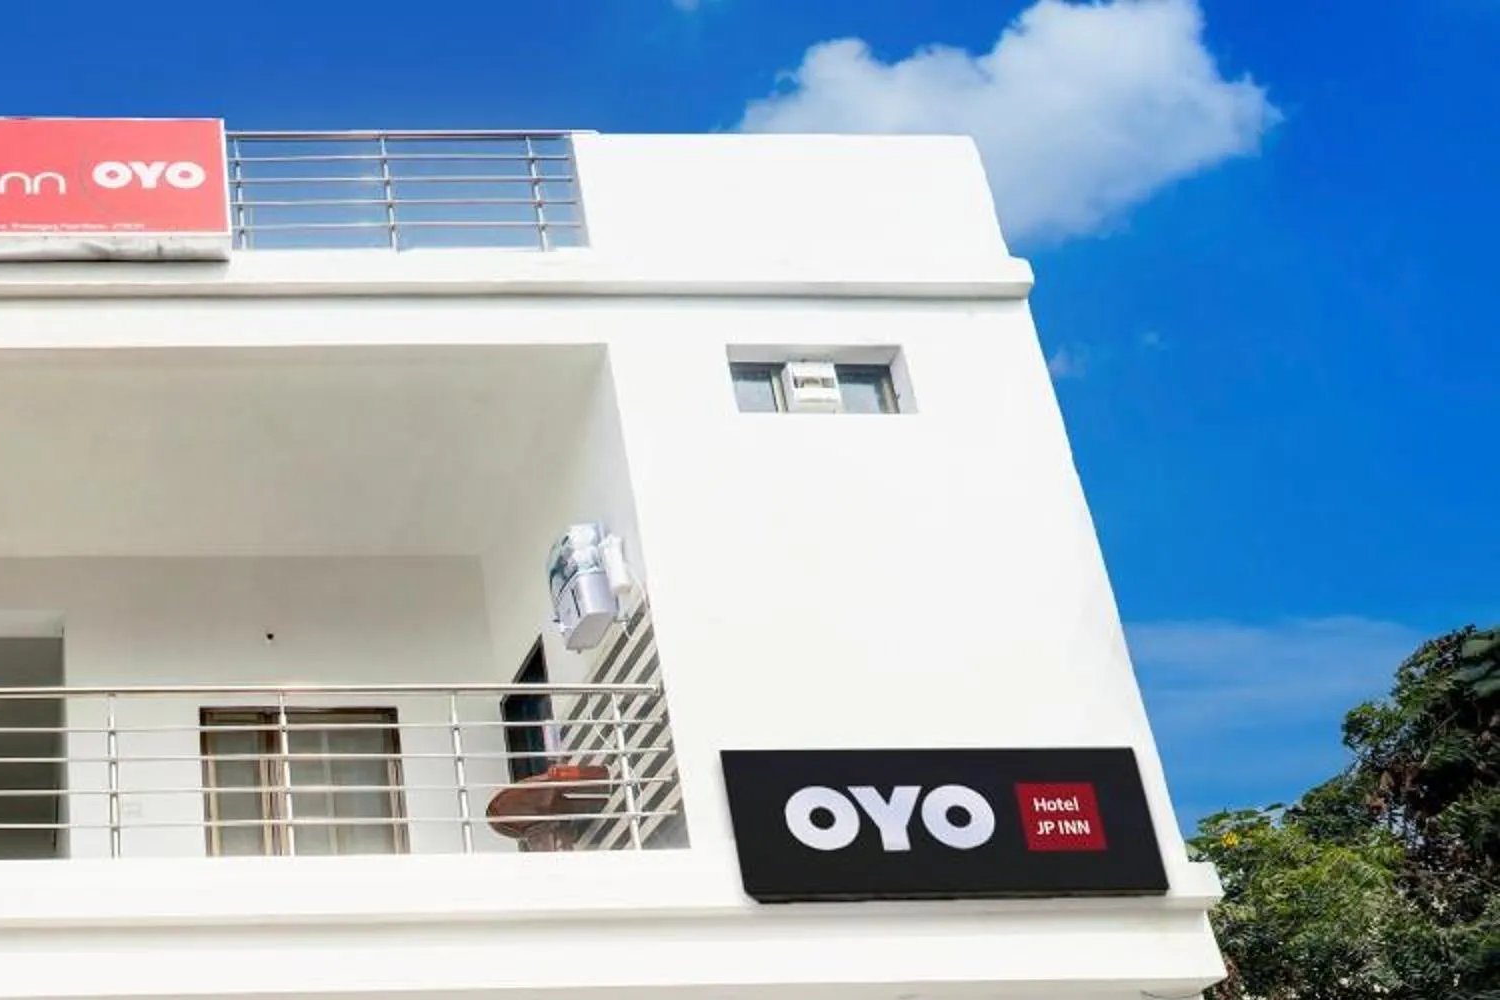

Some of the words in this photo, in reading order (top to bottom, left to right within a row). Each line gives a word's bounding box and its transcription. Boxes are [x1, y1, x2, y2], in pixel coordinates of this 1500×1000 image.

[92, 160, 206, 189] OYO
[1033, 795, 1080, 812] Hotel
[784, 784, 996, 852] OYO
[1036, 820, 1055, 836] JP
[1057, 820, 1091, 836] INN
